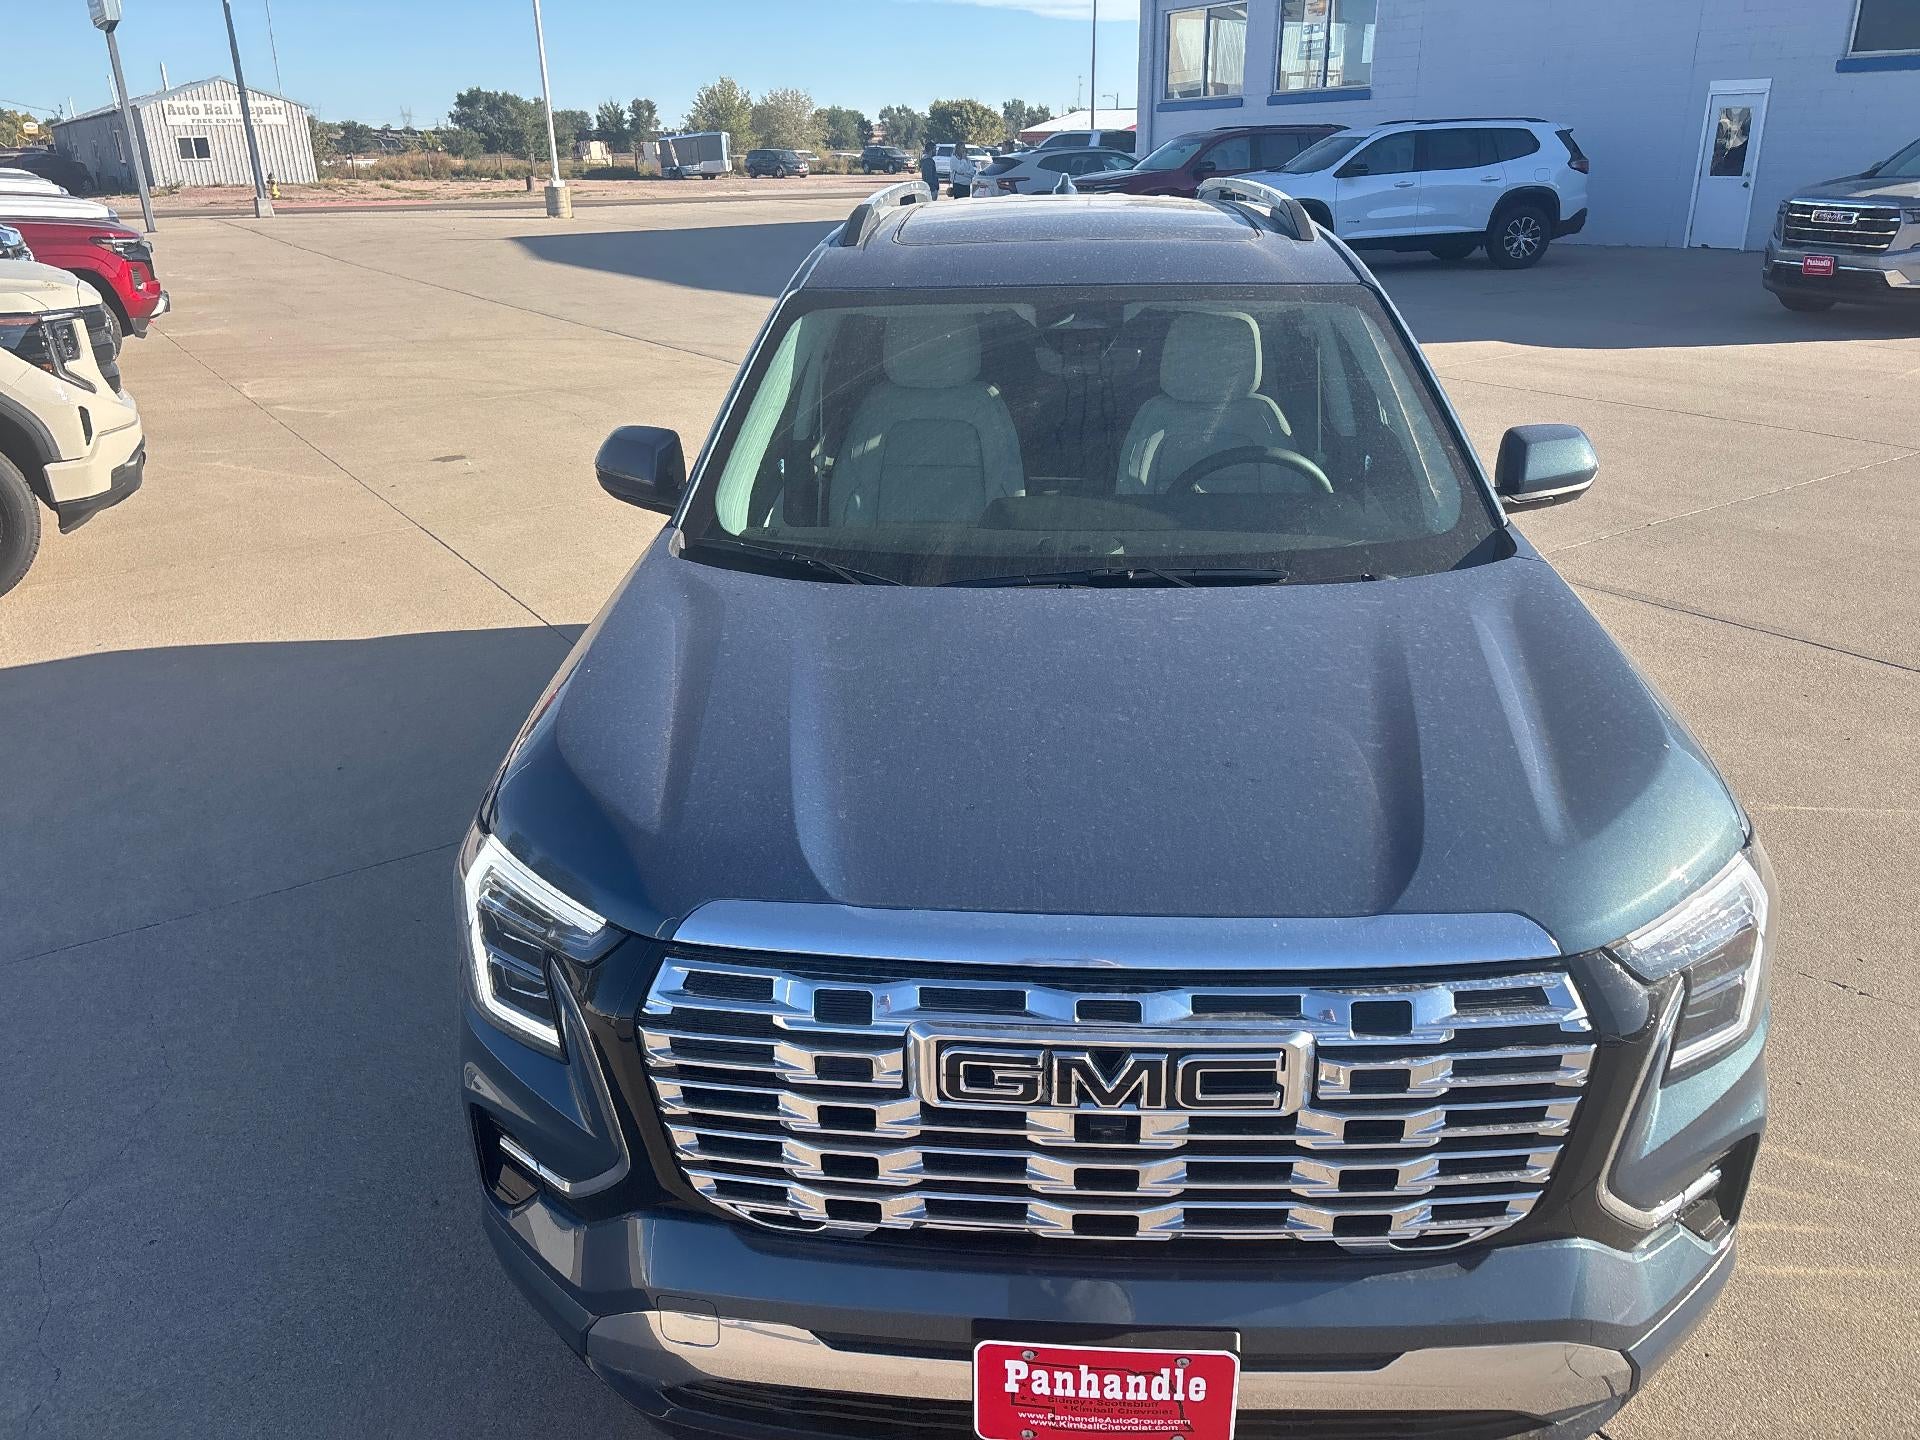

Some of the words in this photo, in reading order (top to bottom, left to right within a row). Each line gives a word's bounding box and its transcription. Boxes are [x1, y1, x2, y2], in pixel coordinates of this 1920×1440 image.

[167, 103, 200, 116] Auto
[203, 103, 233, 116] Hail
[939, 1046, 1286, 1109] GMC
[1004, 1359, 1207, 1401] Panhandle
[1017, 1411, 1191, 1425] www.PanhandleAutoGroup.com
[1029, 1419, 1179, 1431] www.KimballChevrolet.com
